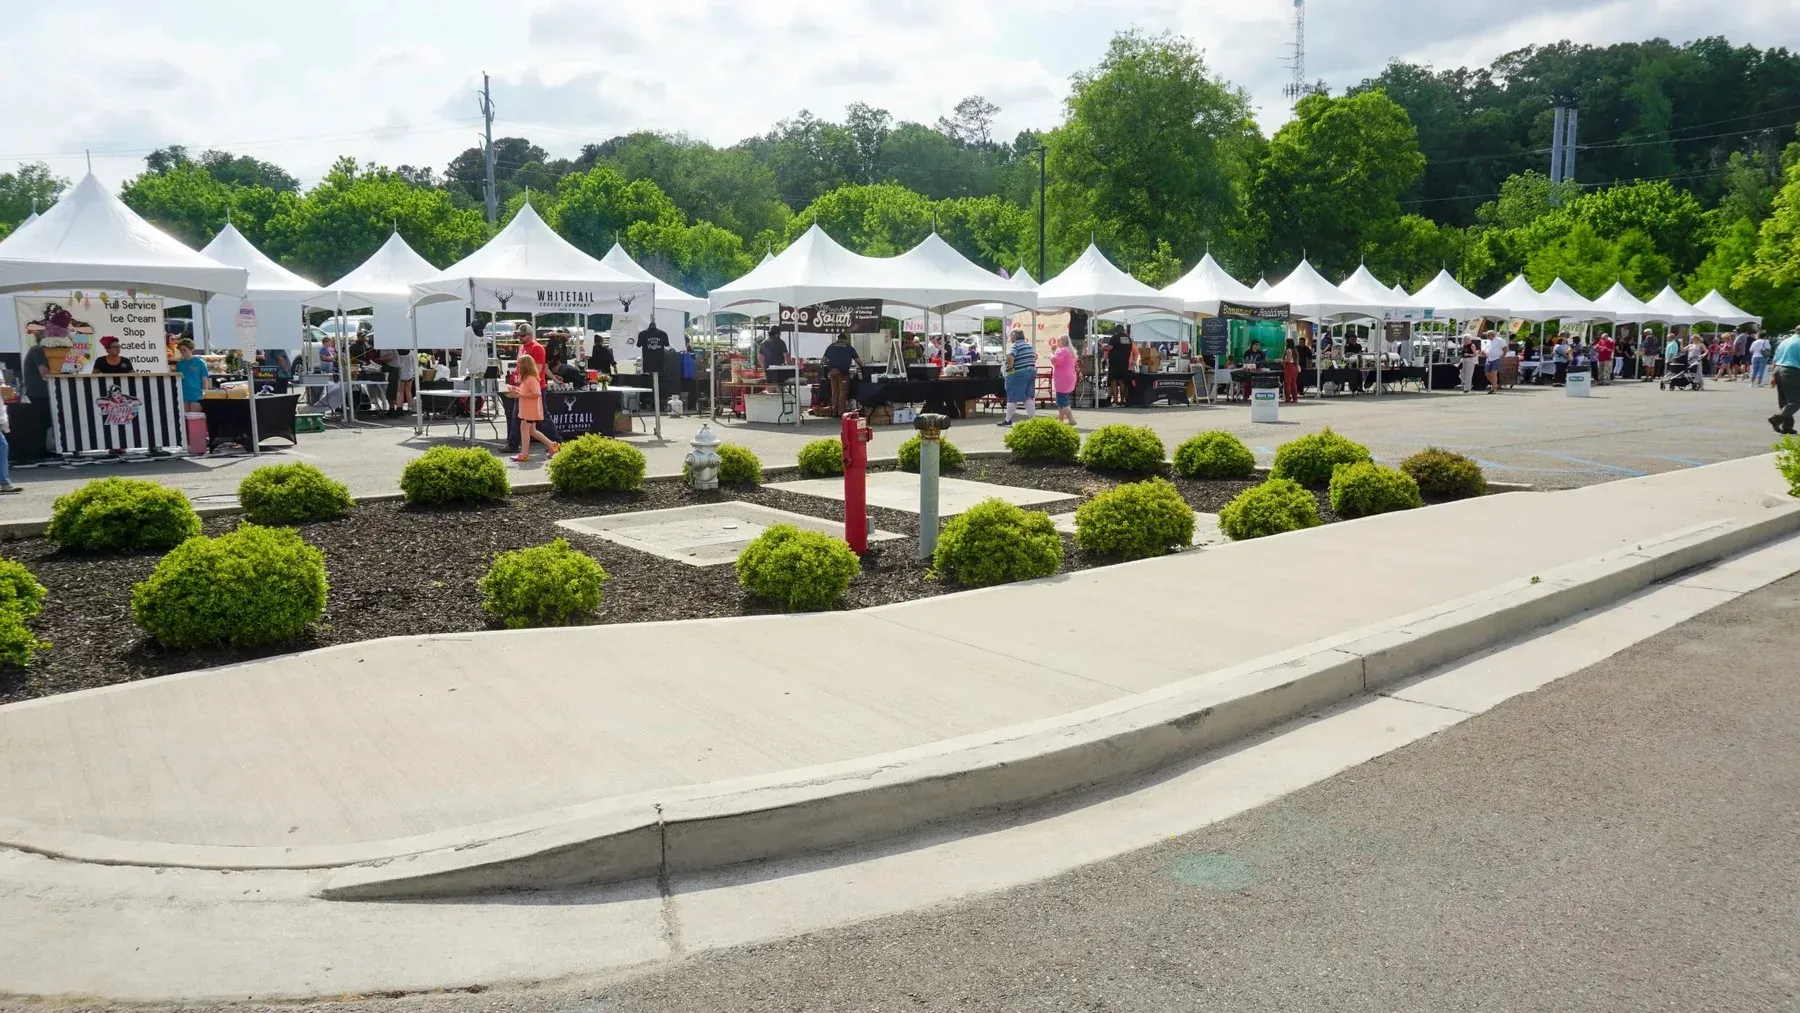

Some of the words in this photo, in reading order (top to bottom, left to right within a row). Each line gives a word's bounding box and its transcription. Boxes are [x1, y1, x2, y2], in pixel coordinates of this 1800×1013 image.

[536, 290, 594, 302] WHITETAIL
[105, 299, 119, 310] Full
[122, 300, 156, 310] Service
[110, 313, 124, 323] Ice
[126, 313, 156, 323] Cream
[812, 308, 852, 328] South
[123, 326, 146, 338] Shop
[905, 320, 939, 332] NIN'S
[120, 340, 146, 350] cated
[148, 340, 157, 350] in
[550, 412, 593, 424] HITETAIL
